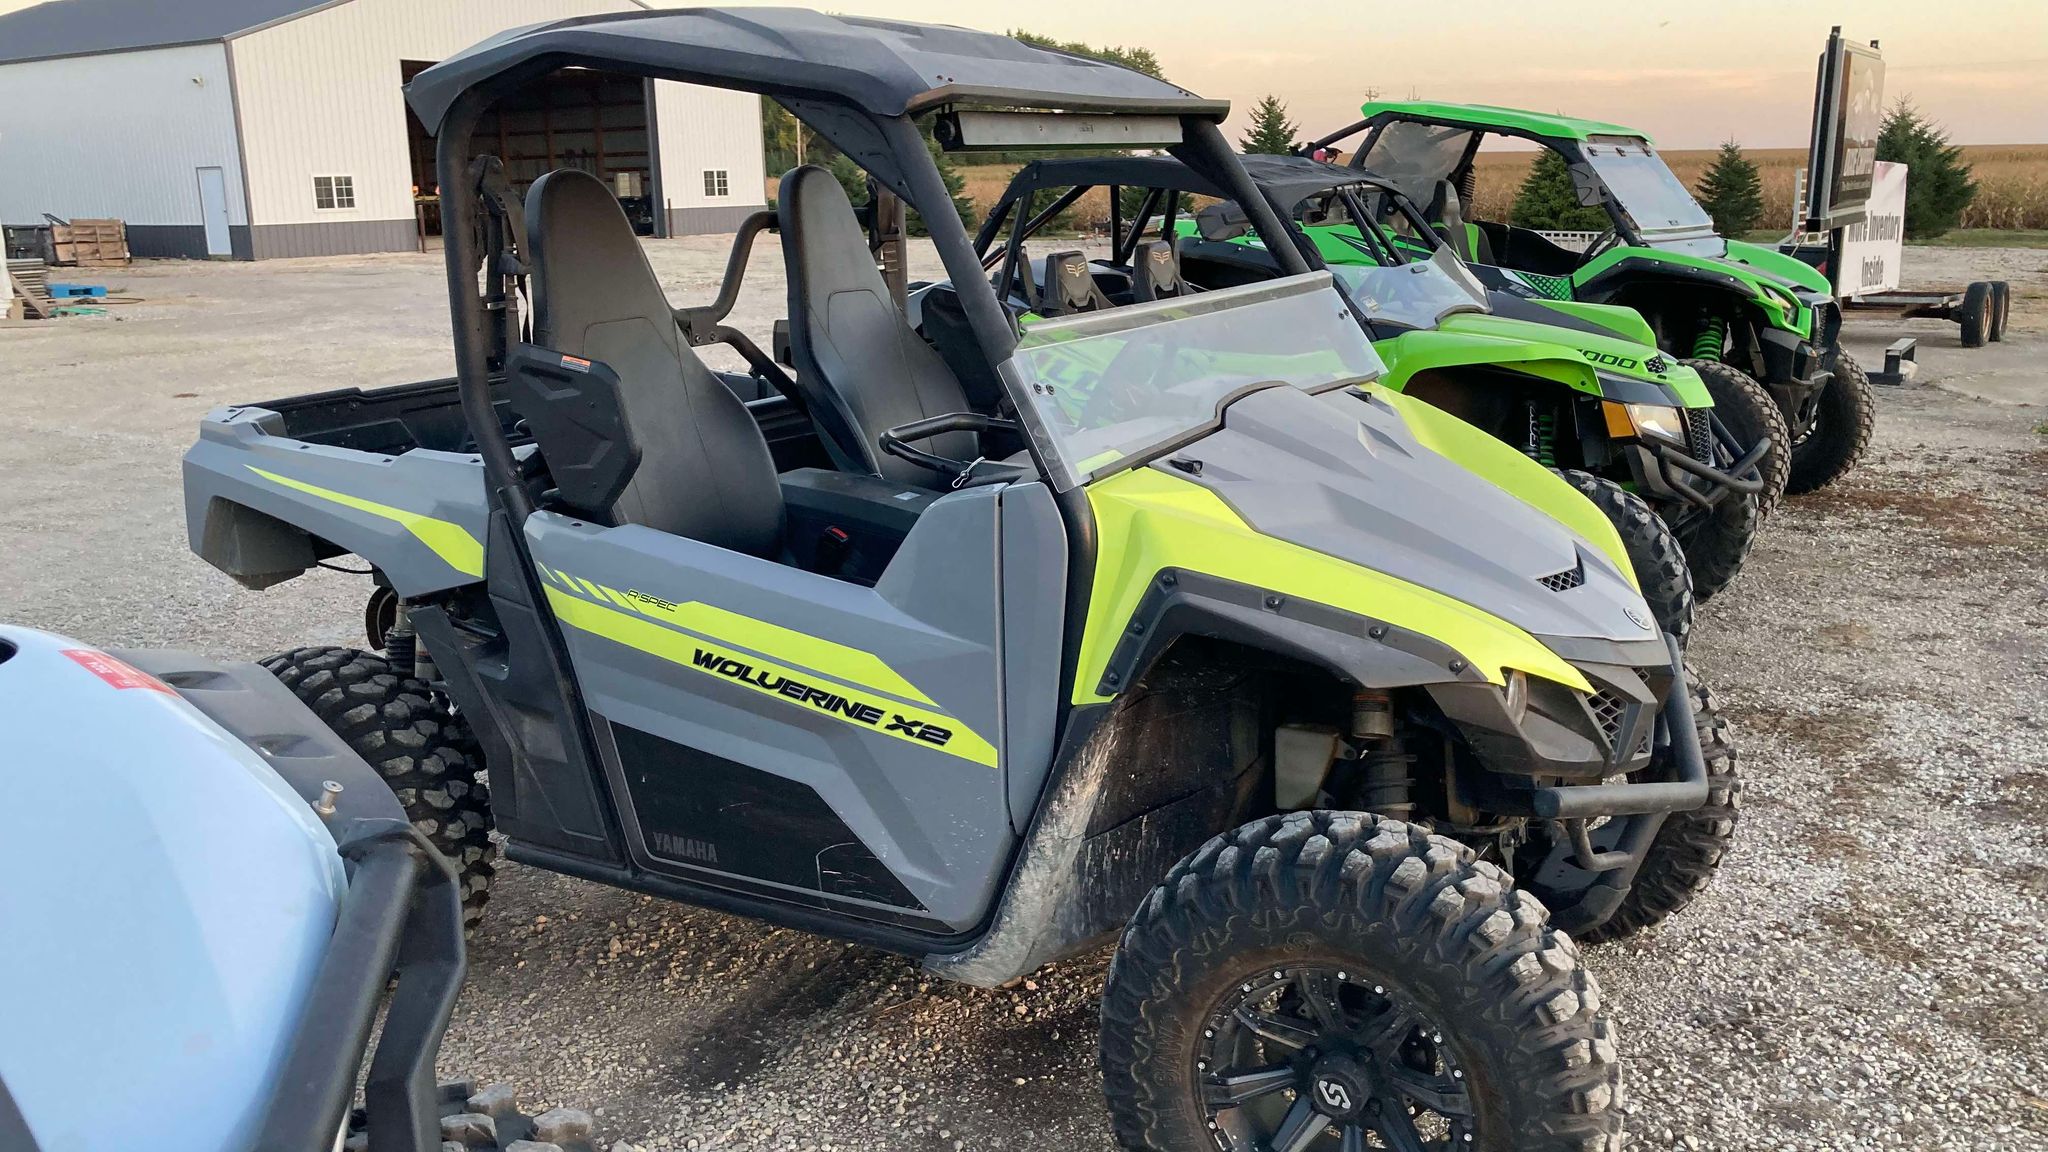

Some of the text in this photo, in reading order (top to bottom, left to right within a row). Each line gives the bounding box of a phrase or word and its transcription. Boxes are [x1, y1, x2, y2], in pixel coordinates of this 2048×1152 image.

[1868, 210, 1901, 243] Inventory
[1861, 256, 1884, 287] Inside
[1576, 348, 1638, 369] 000
[692, 648, 953, 747] WOLVERINE X2
[652, 831, 718, 863] YAMAHA
